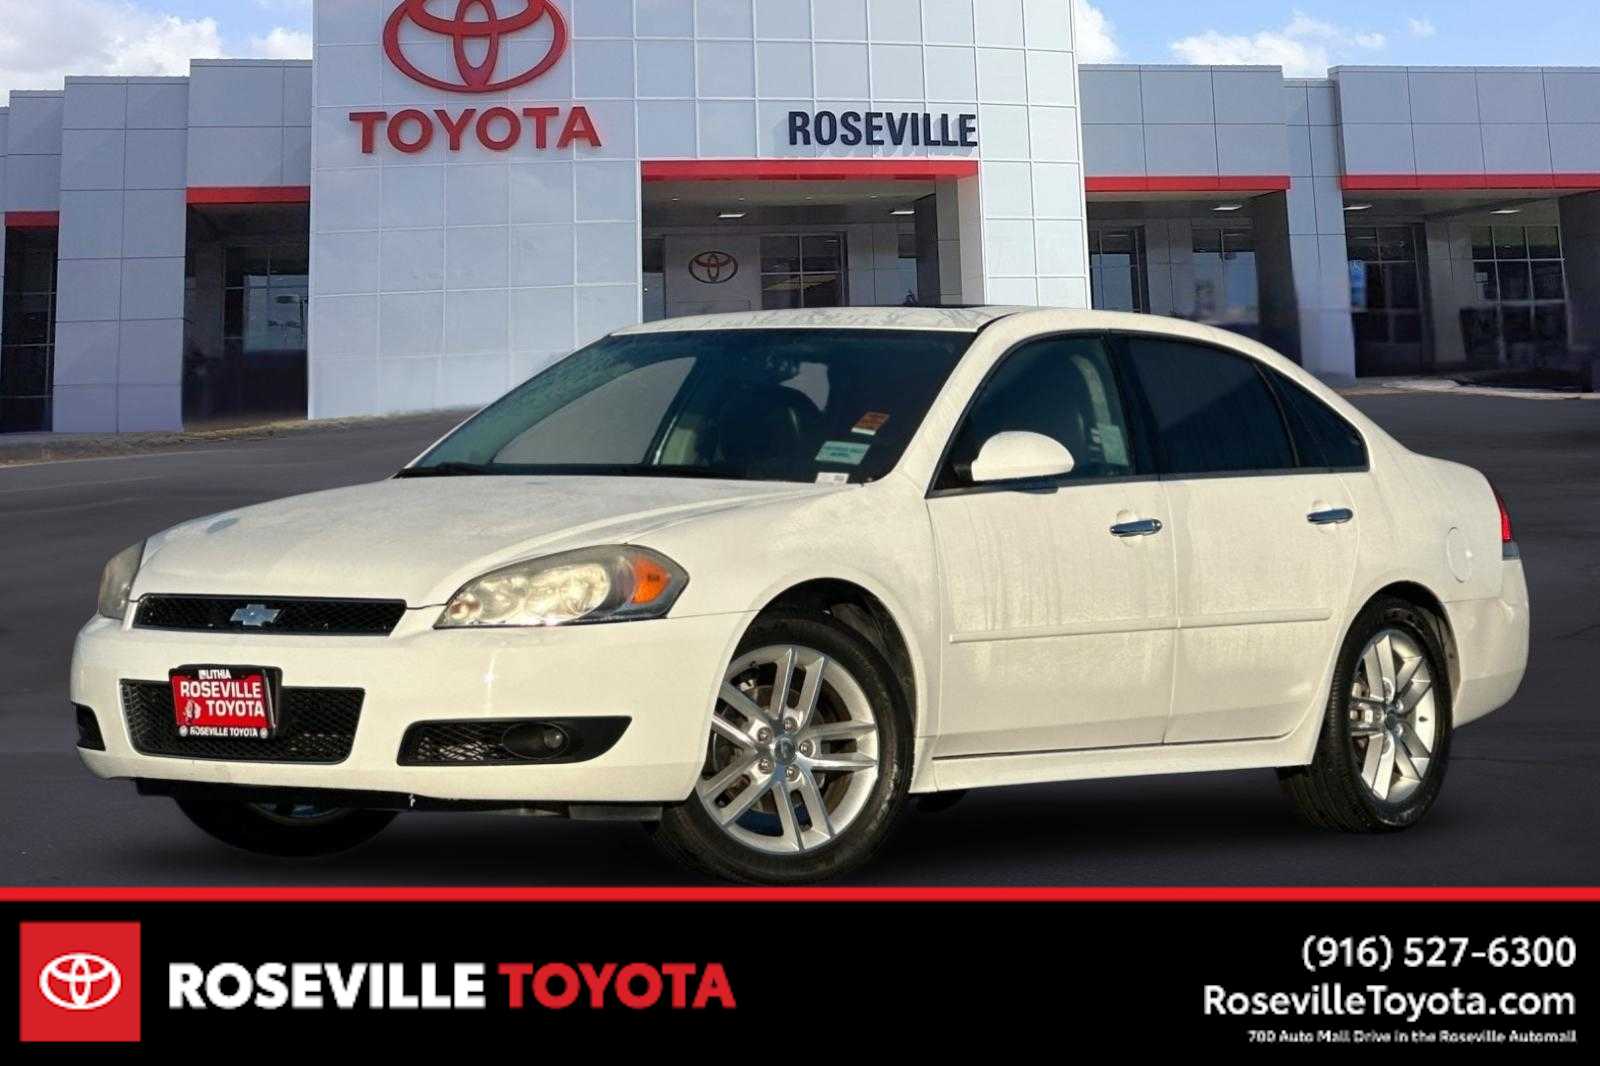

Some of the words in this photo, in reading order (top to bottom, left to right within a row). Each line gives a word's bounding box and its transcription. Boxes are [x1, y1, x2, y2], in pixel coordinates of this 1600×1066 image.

[349, 106, 602, 153] TOYOTA
[788, 111, 978, 147] ROSEVILLE
[180, 681, 262, 698] ROSEVILLE
[205, 700, 265, 717] TOYOTA
[189, 726, 228, 737] ROSEVILLE
[229, 727, 258, 737] TOYOTA
